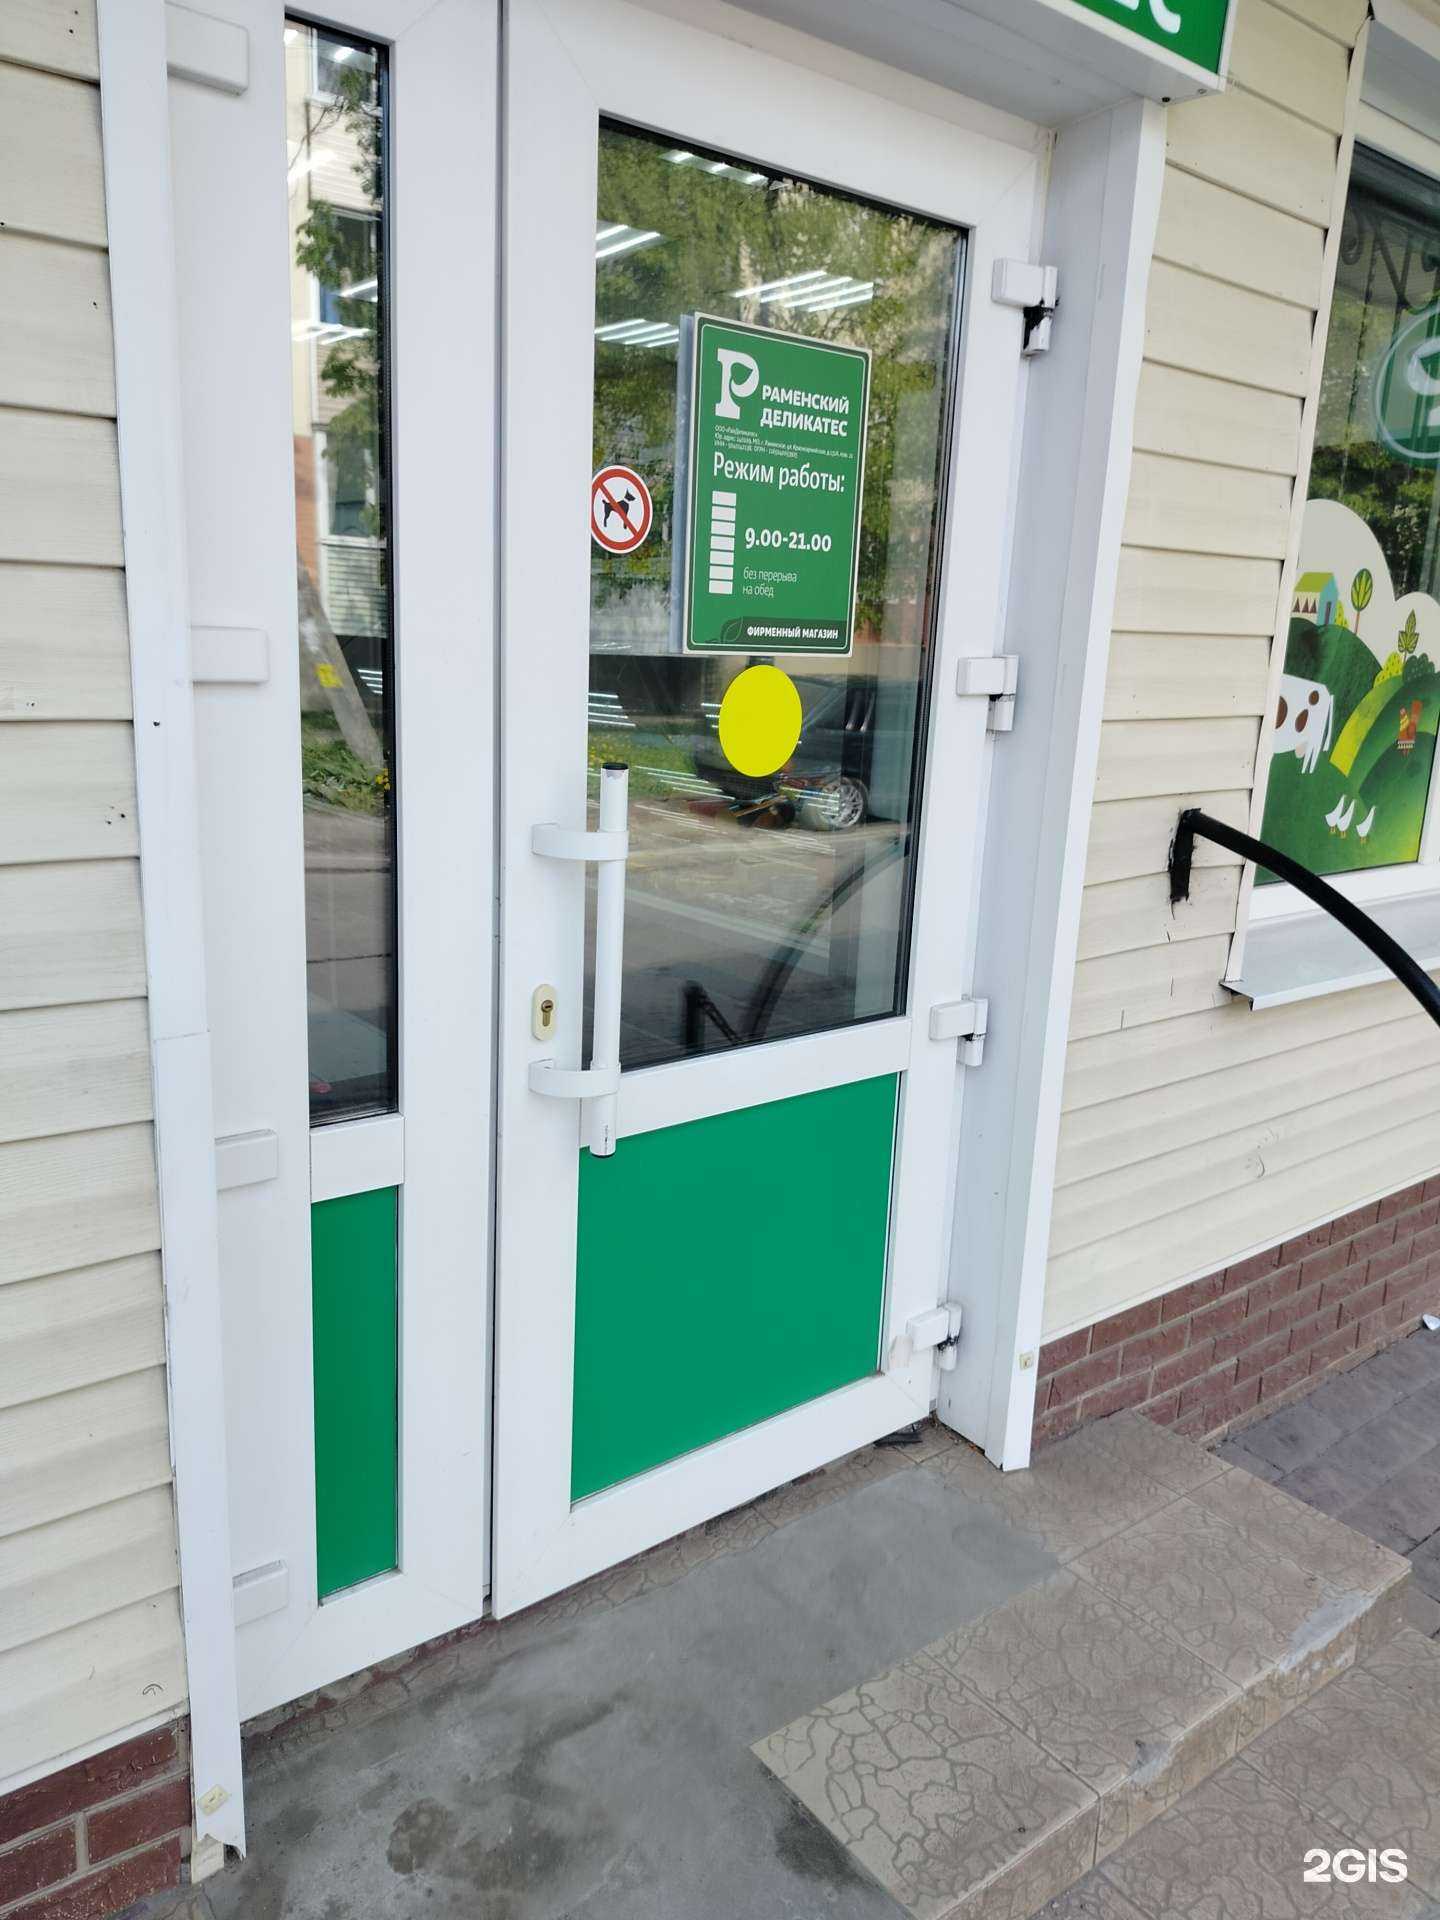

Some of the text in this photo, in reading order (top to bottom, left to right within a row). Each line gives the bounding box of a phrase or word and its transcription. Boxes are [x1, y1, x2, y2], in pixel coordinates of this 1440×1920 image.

[762, 384, 849, 414] РАМЕНСКИЙ
[760, 407, 848, 436] ДЕЛИКАТЕС
[713, 451, 845, 492] Режим работы:
[745, 527, 832, 552] 9.00-21.00
[743, 566, 798, 583] без перерыва
[742, 583, 774, 598] на обед
[747, 625, 839, 639] ФИРМЕННЫЙ МАГАЗИН
